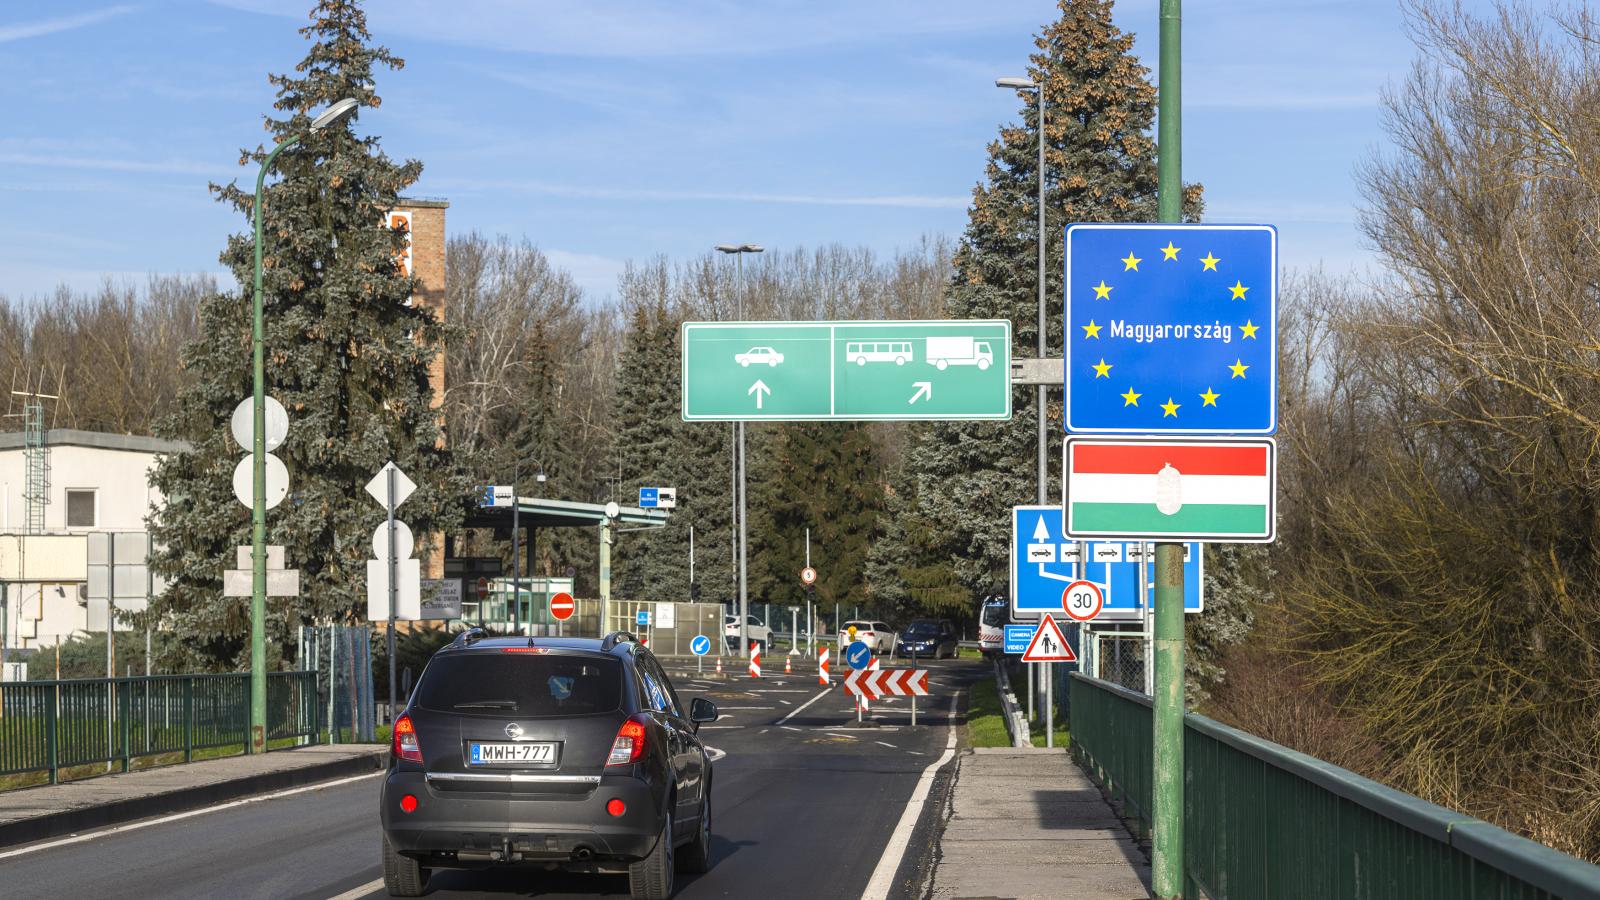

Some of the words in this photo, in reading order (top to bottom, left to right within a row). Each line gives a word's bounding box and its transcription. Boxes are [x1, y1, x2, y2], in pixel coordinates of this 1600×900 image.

[1110, 320, 1231, 343] Magyarország
[1073, 593, 1092, 608] 30
[483, 746, 551, 759] MWH-777
